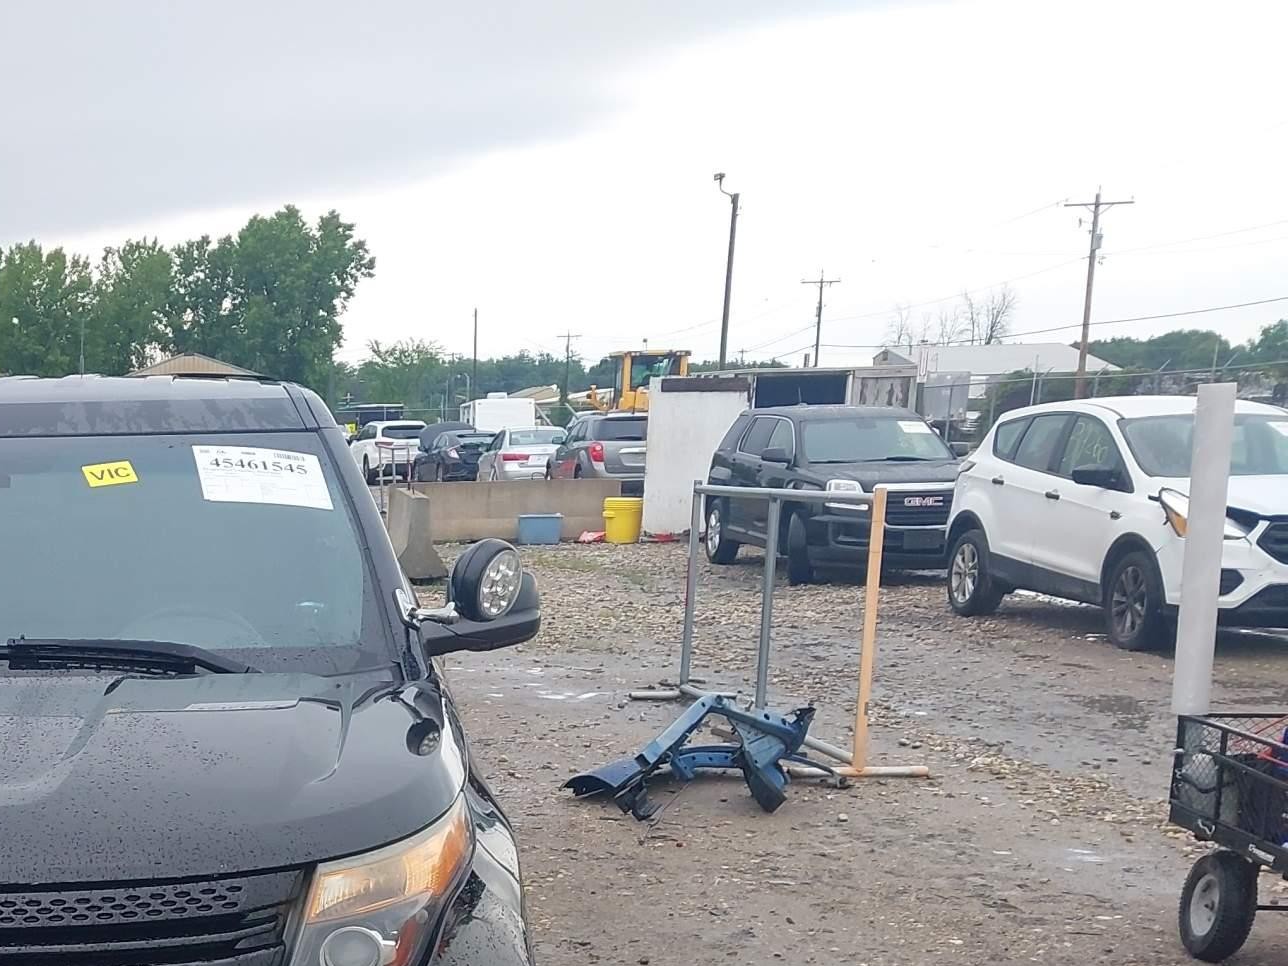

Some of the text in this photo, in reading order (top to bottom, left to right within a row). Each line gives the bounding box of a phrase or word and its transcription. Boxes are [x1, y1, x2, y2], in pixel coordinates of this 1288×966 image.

[89, 466, 131, 481] VIC
[209, 457, 308, 475] 45461545
[904, 496, 943, 506] GMC
